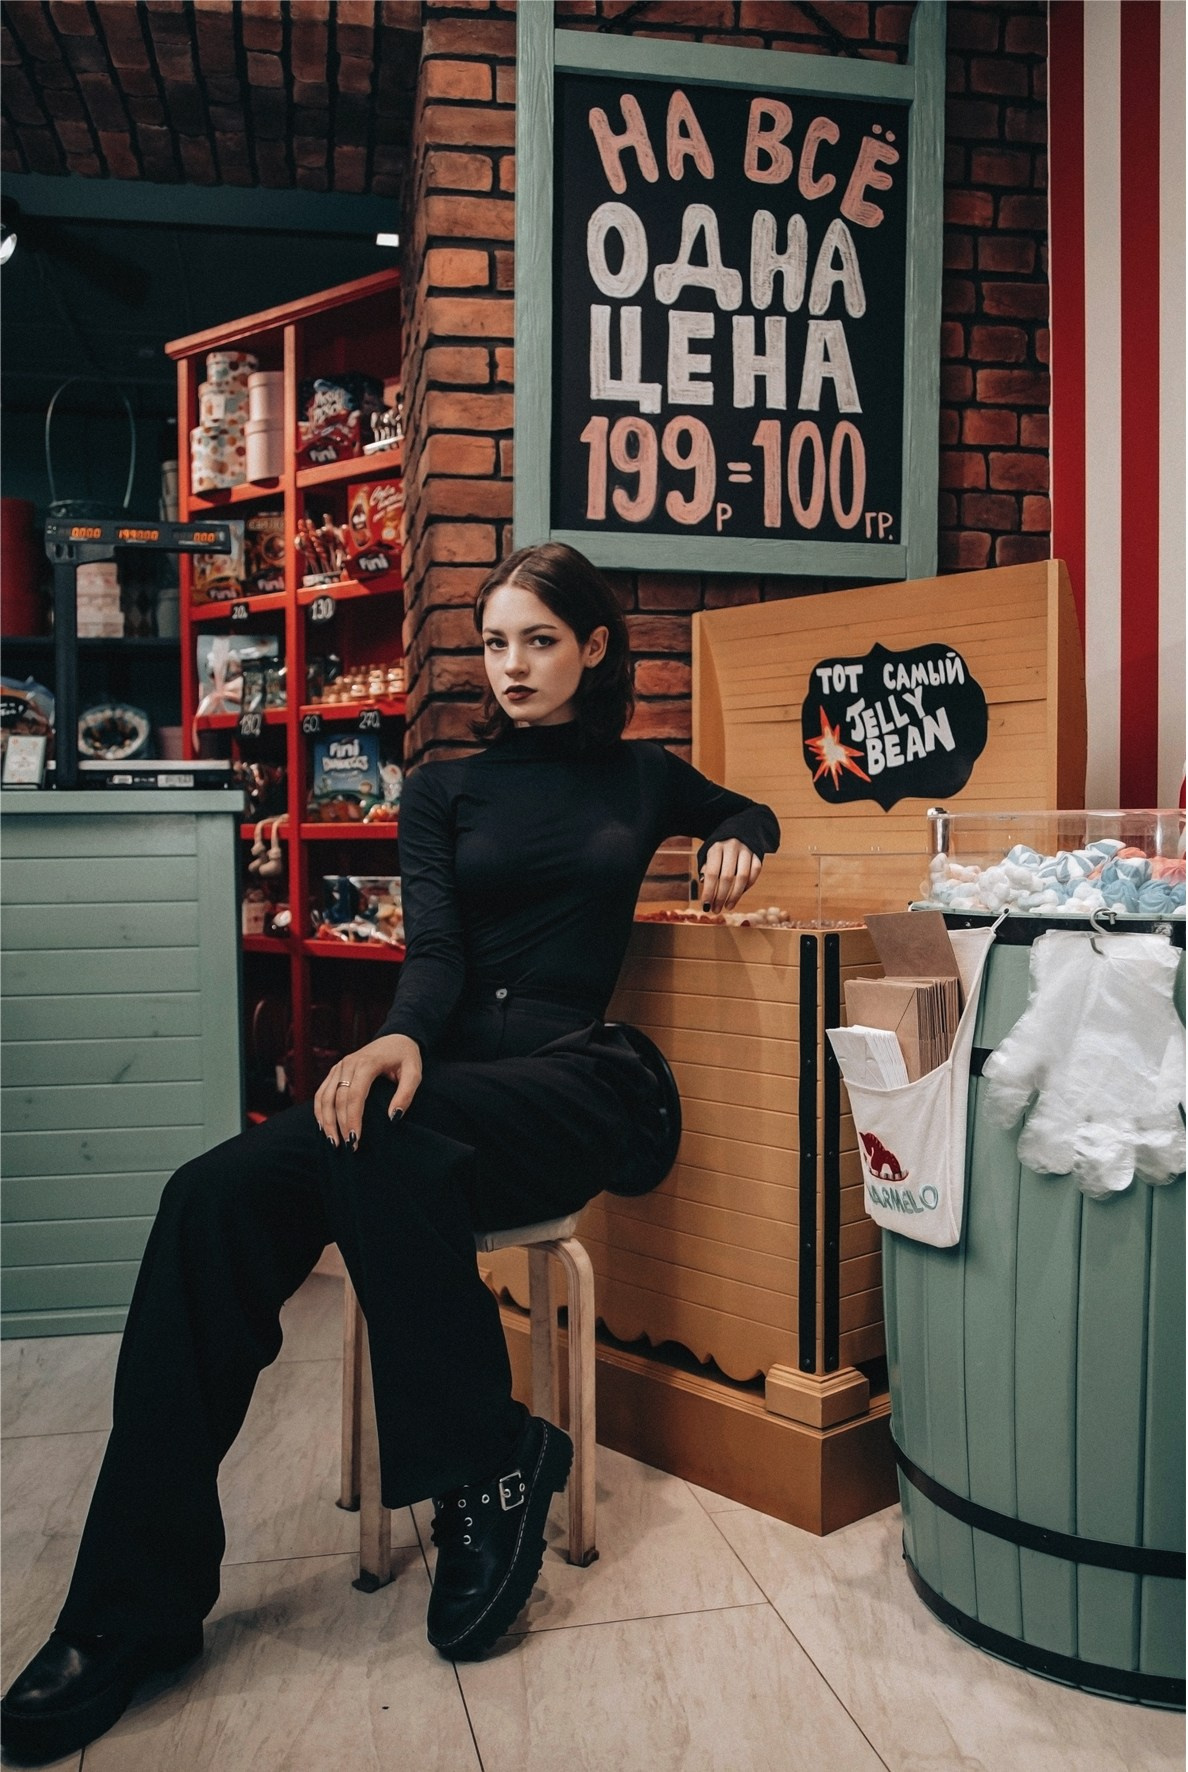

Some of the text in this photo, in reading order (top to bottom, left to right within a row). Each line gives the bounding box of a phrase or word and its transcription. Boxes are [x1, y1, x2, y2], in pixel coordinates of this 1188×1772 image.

[588, 89, 900, 228] НА ВСЁ
[586, 201, 867, 319] ОДНА
[589, 303, 864, 414] ЦЕНА
[816, 652, 965, 694] ТОТ САМЫЙ
[845, 685, 926, 742] JELLY
[865, 707, 956, 775] BEAN
[866, 1184, 939, 1214] ARMELO
